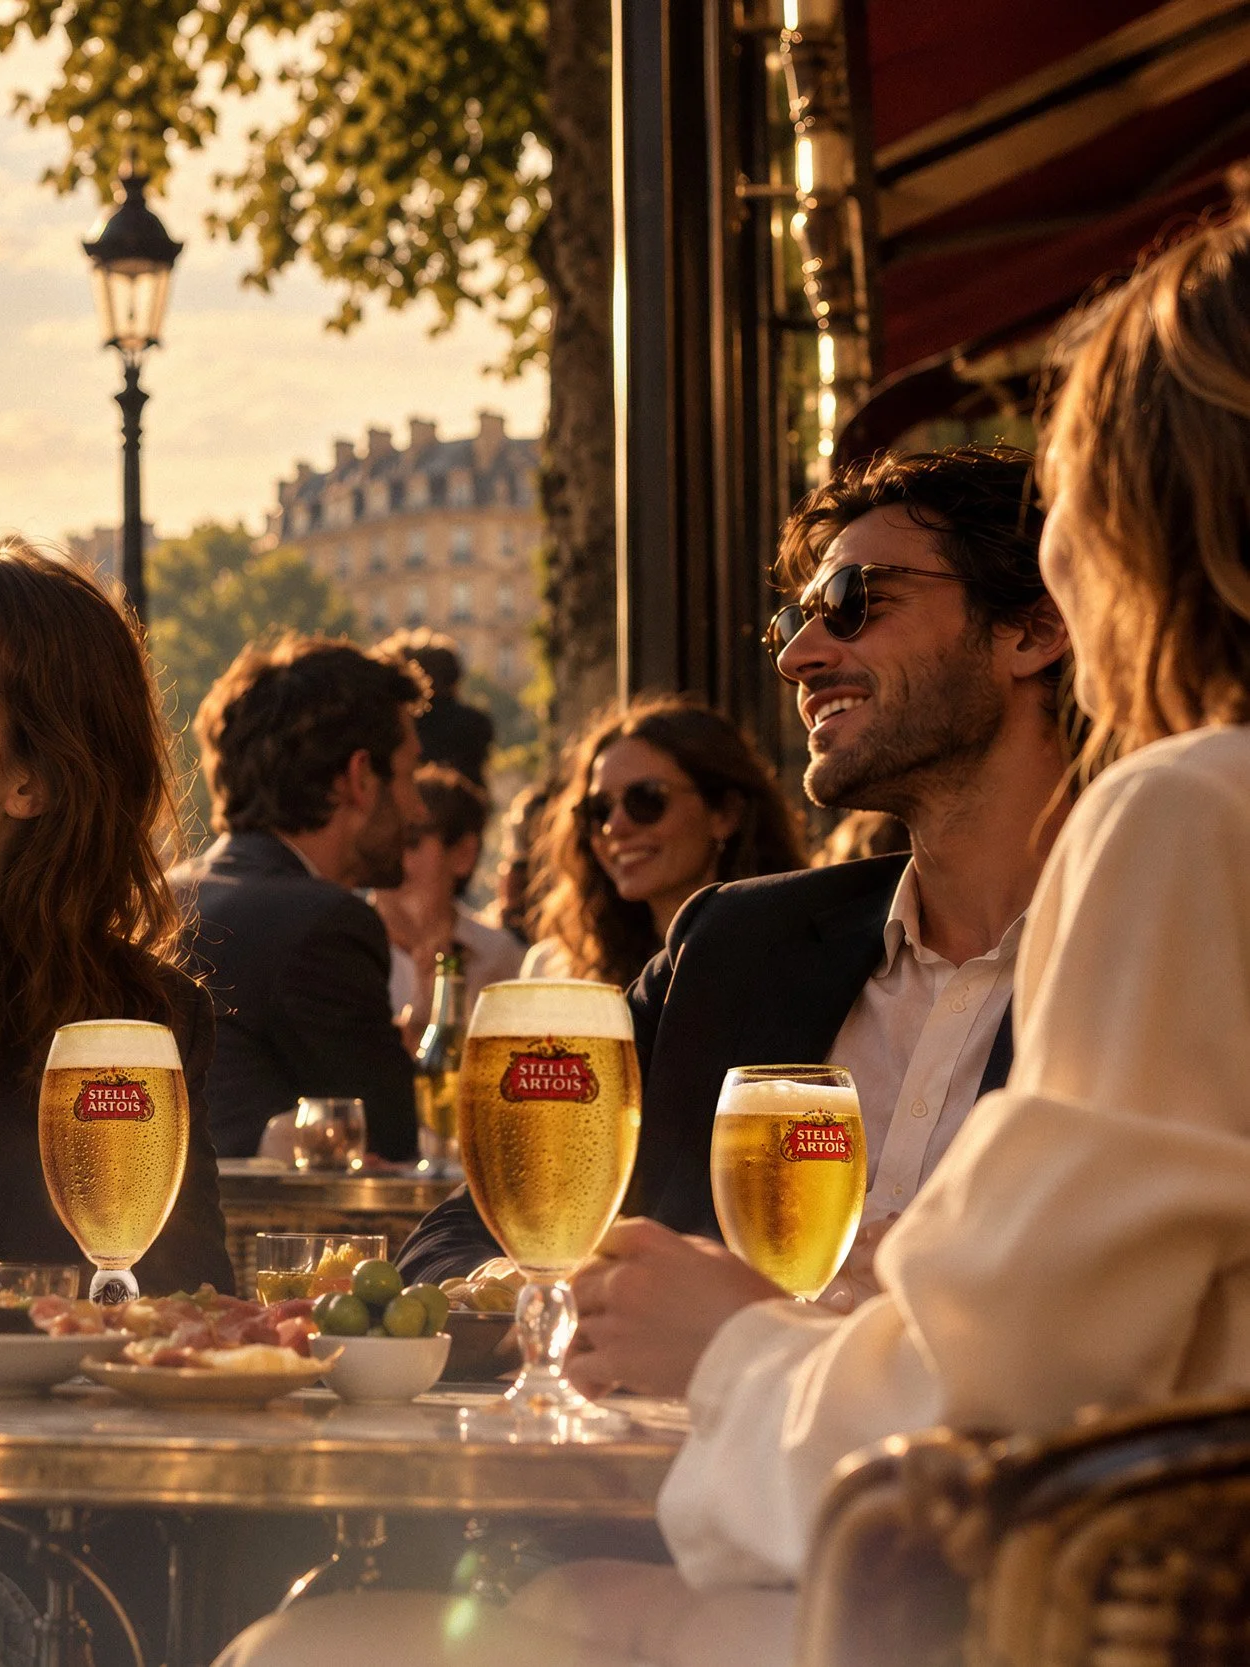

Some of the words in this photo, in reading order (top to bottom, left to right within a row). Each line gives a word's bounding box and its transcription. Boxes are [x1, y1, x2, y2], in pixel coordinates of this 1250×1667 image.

[519, 1063, 581, 1076] STELLA
[518, 1077, 582, 1091] ARTOIS
[88, 1089, 140, 1100] STELLA
[87, 1101, 141, 1112] ARTOIS
[797, 1129, 845, 1141] STELLA
[796, 1142, 846, 1153] ARTOIS
